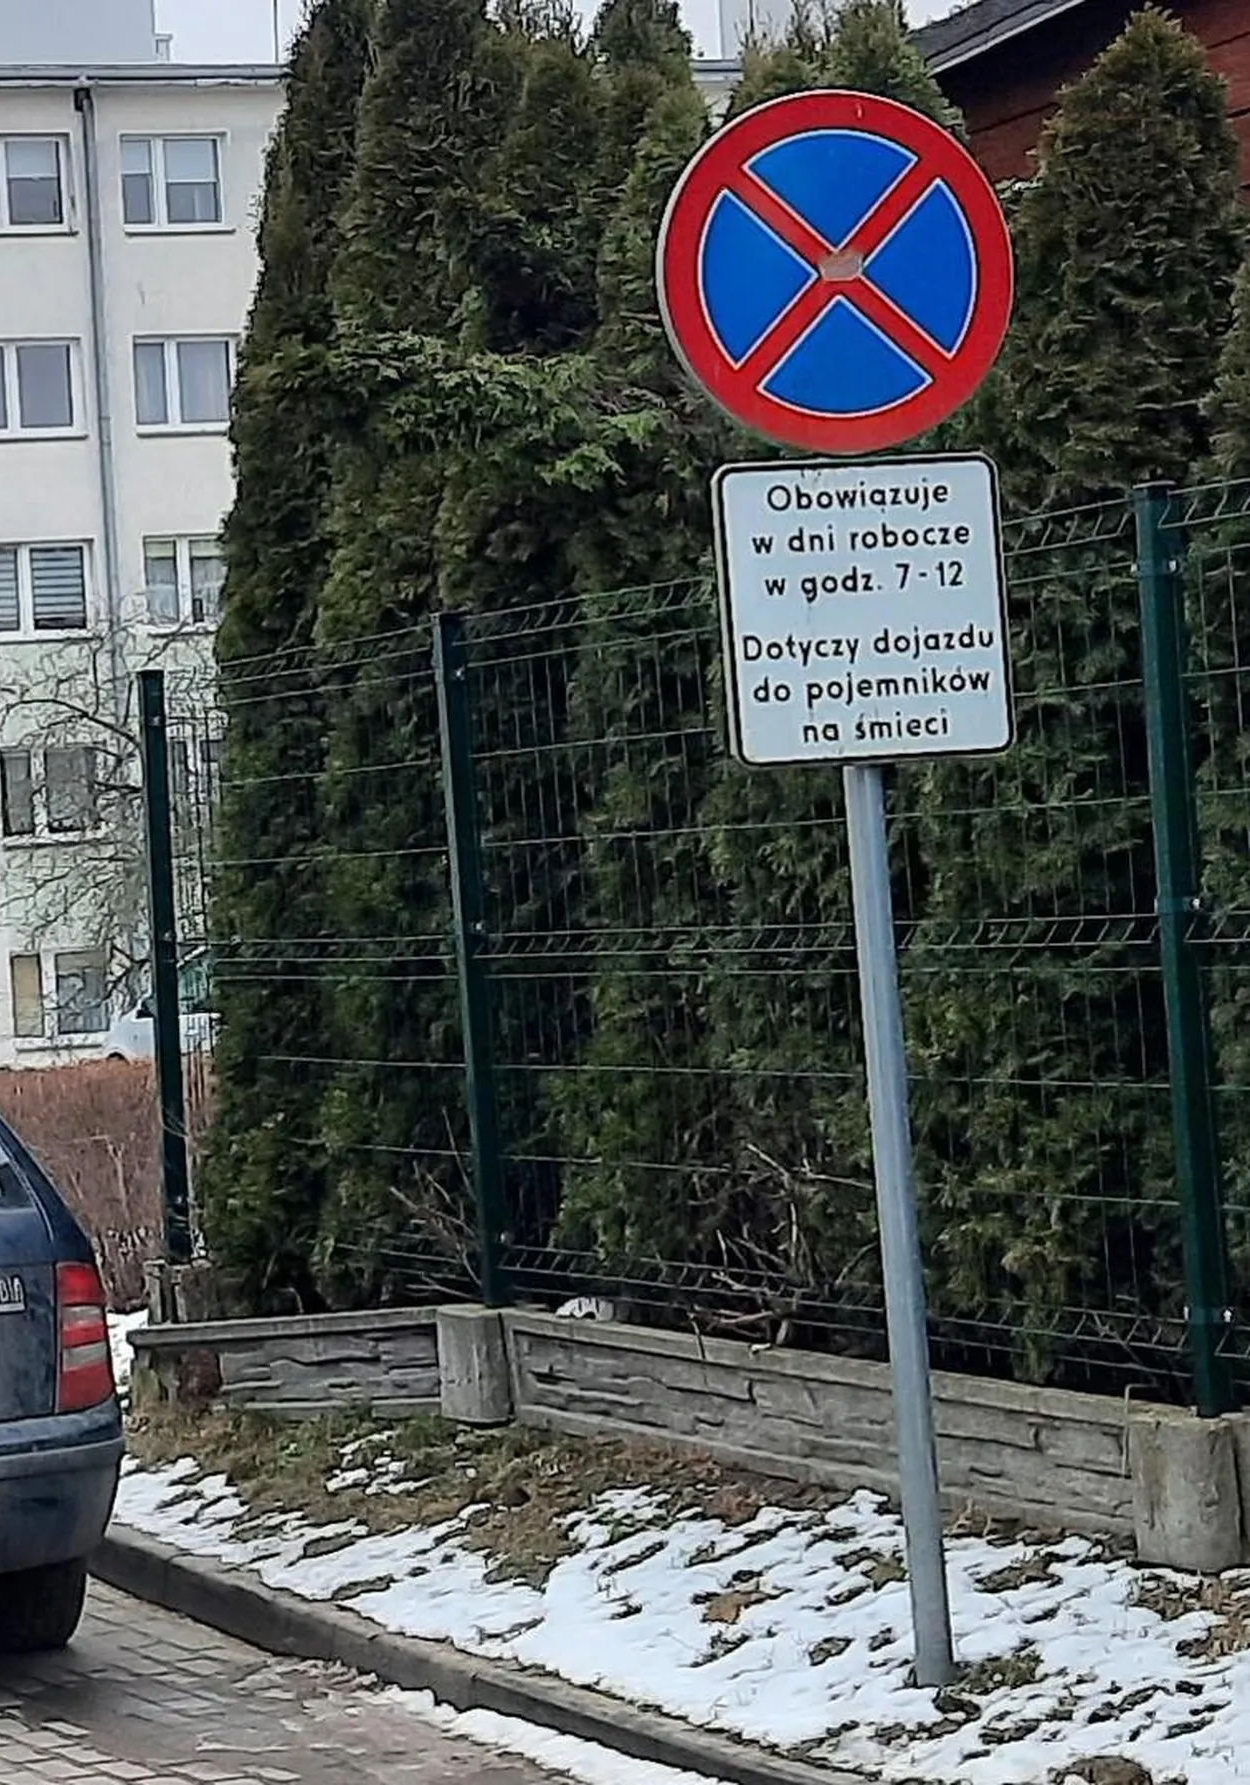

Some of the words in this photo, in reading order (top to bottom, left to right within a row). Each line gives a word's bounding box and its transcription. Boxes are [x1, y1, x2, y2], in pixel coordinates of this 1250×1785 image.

[767, 478, 948, 513] Obowiązuje
[753, 535, 774, 555] w
[788, 525, 835, 553] dni
[849, 522, 971, 550] robocze
[765, 576, 786, 597] w
[801, 567, 883, 603] godz.
[743, 635, 859, 666] Dotyczy
[874, 625, 994, 659] dojazdu
[753, 678, 791, 702] do
[806, 668, 990, 709] pojemników
[803, 725, 839, 743] na
[855, 708, 949, 741] śmieci
